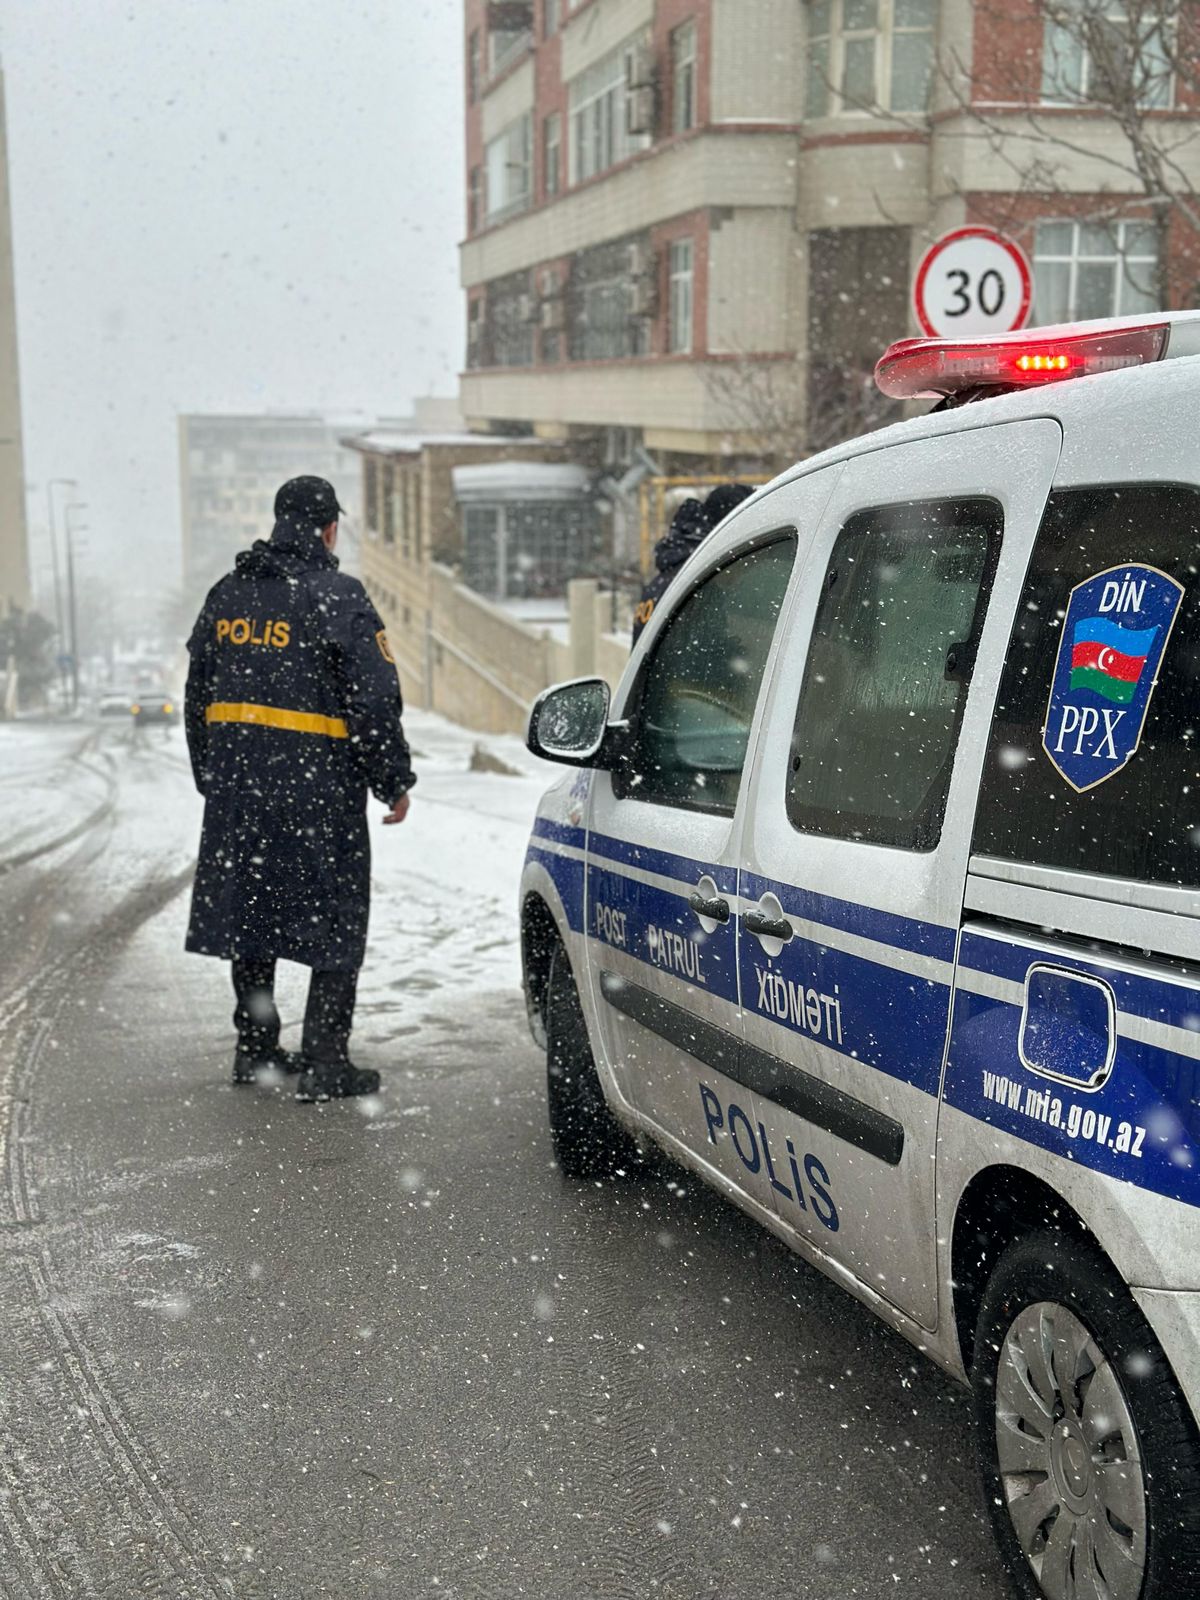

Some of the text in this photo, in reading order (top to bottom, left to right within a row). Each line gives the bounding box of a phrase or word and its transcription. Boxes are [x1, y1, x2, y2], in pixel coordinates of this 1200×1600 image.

[944, 268, 1005, 317] 30
[1053, 704, 1127, 760] PPX
[596, 902, 627, 947] POST
[648, 924, 706, 983] PATRUL
[981, 1069, 1147, 1158] www.mia.gov.az
